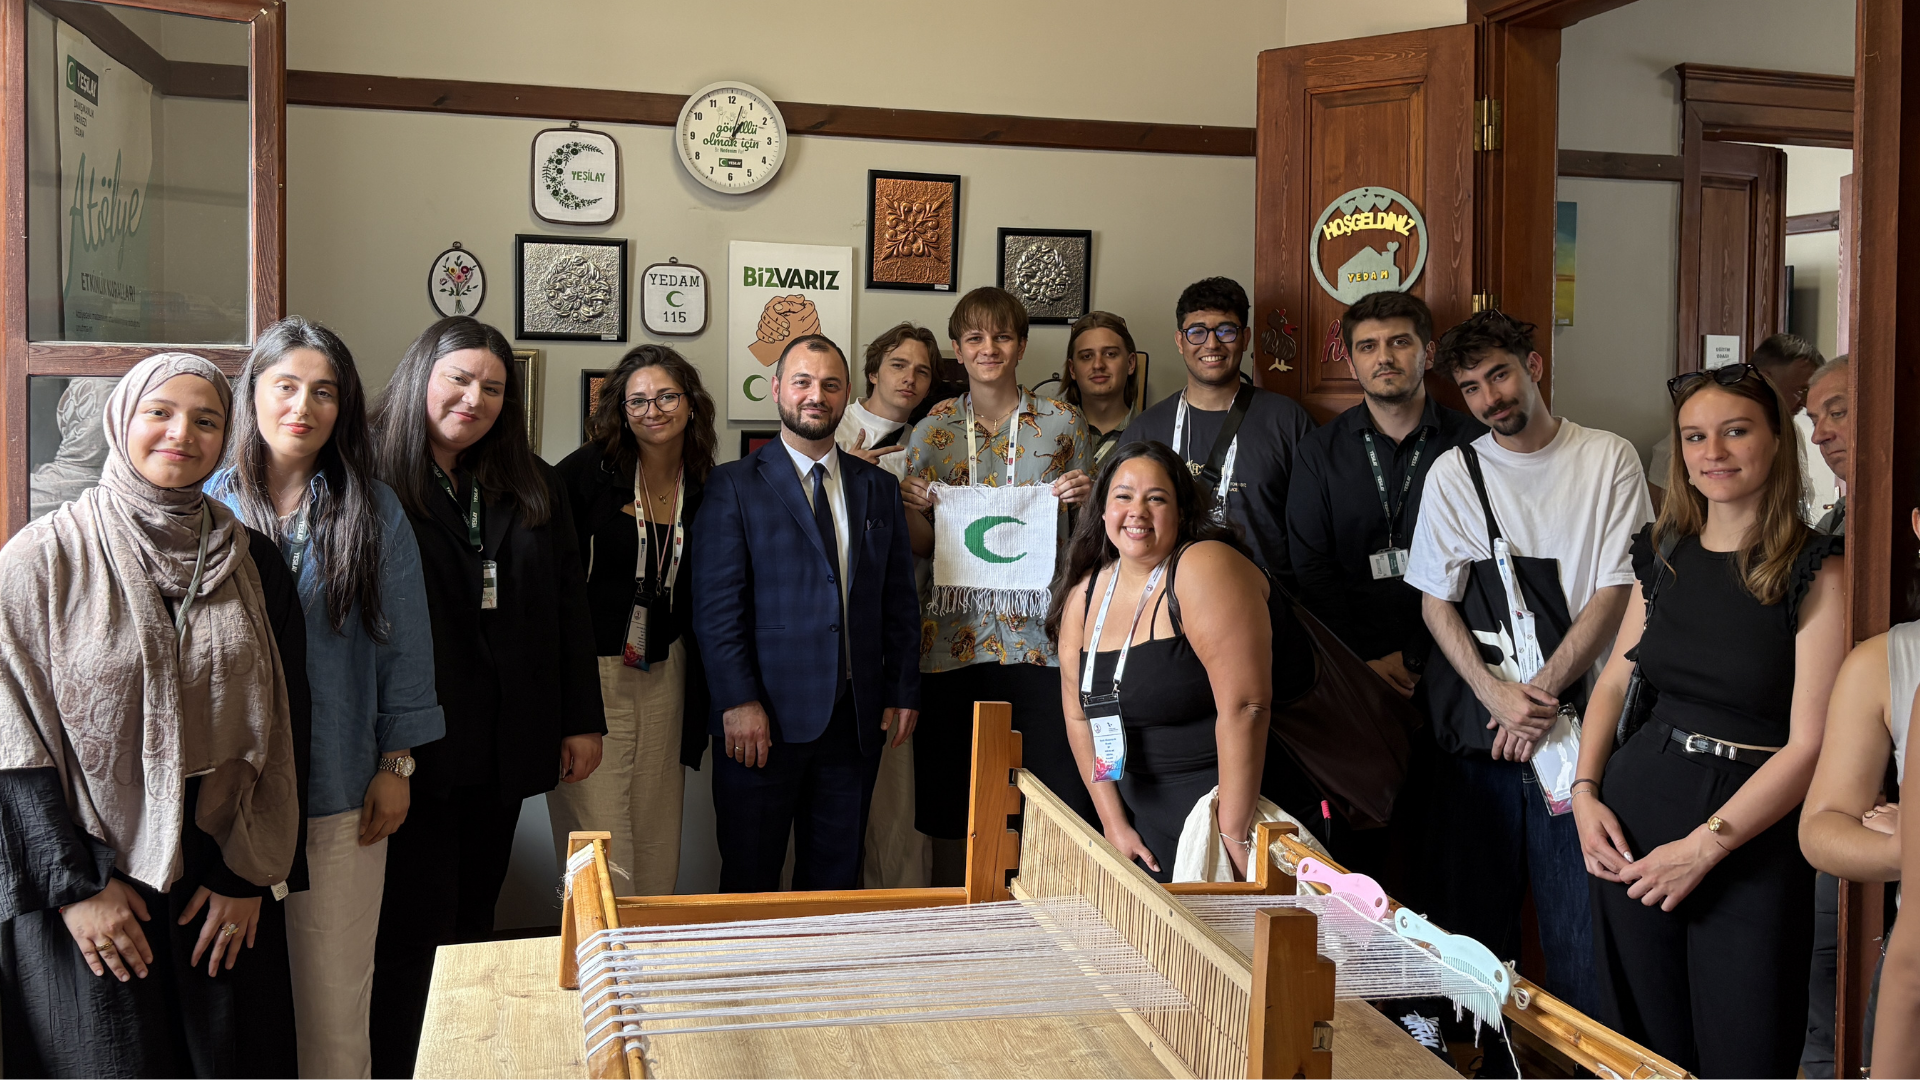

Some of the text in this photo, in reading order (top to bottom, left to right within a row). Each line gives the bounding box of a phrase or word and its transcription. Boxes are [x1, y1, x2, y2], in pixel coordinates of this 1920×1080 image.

[710, 99, 717, 108] 11
[728, 96, 736, 104] 12
[694, 112, 702, 120] 10
[762, 117, 767, 125] 2
[690, 131, 695, 140] 9
[703, 132, 759, 151] olmak için
[767, 137, 772, 145] 3
[695, 151, 700, 160] 8
[761, 156, 767, 164] 4
[710, 166, 714, 175] 7
[747, 169, 752, 177] 5
[571, 169, 605, 182] YEŞİLAY
[728, 173, 733, 181] 6
[66, 148, 140, 272] Atölye
[649, 273, 700, 287] YEDAM
[1347, 270, 1389, 283] YEDAM
[663, 310, 687, 323] 115
